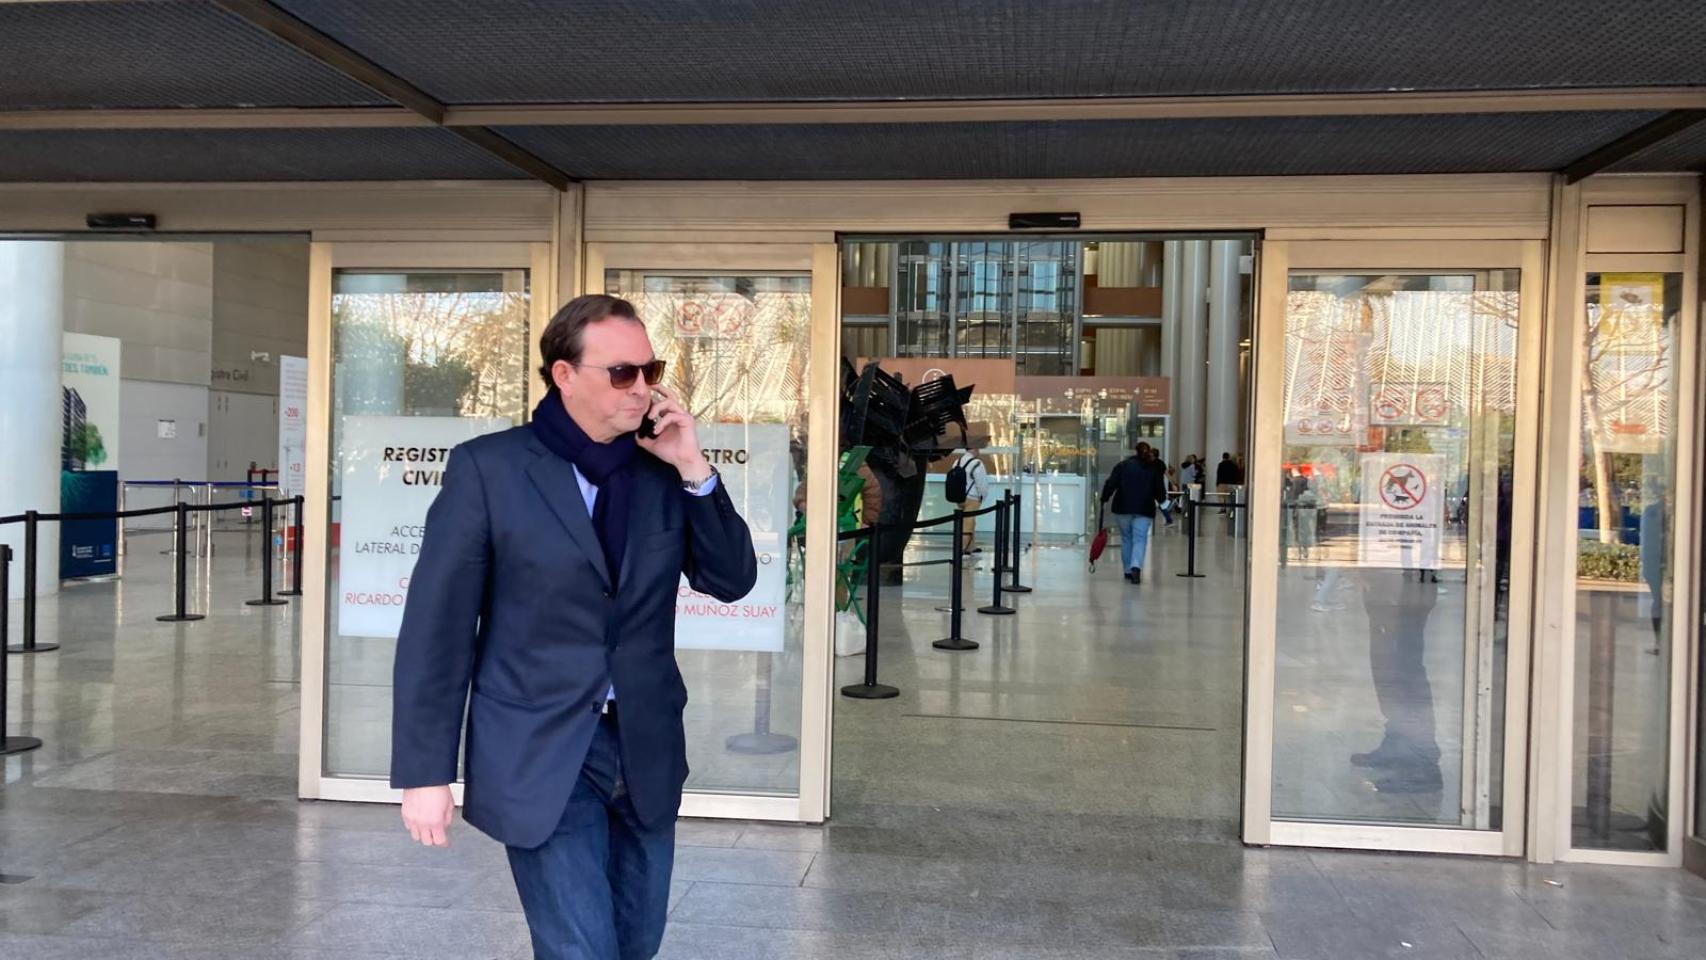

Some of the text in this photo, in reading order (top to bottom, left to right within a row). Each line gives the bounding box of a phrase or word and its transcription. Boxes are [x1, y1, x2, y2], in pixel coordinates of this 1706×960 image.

[384, 447, 449, 462] REGIST
[701, 449, 747, 464] STRO
[391, 525, 426, 538] ACCE
[355, 541, 406, 555] LATERAL
[345, 592, 403, 606] RICARDO
[684, 601, 739, 617] MUÑOZ
[743, 606, 777, 618] SUAY
